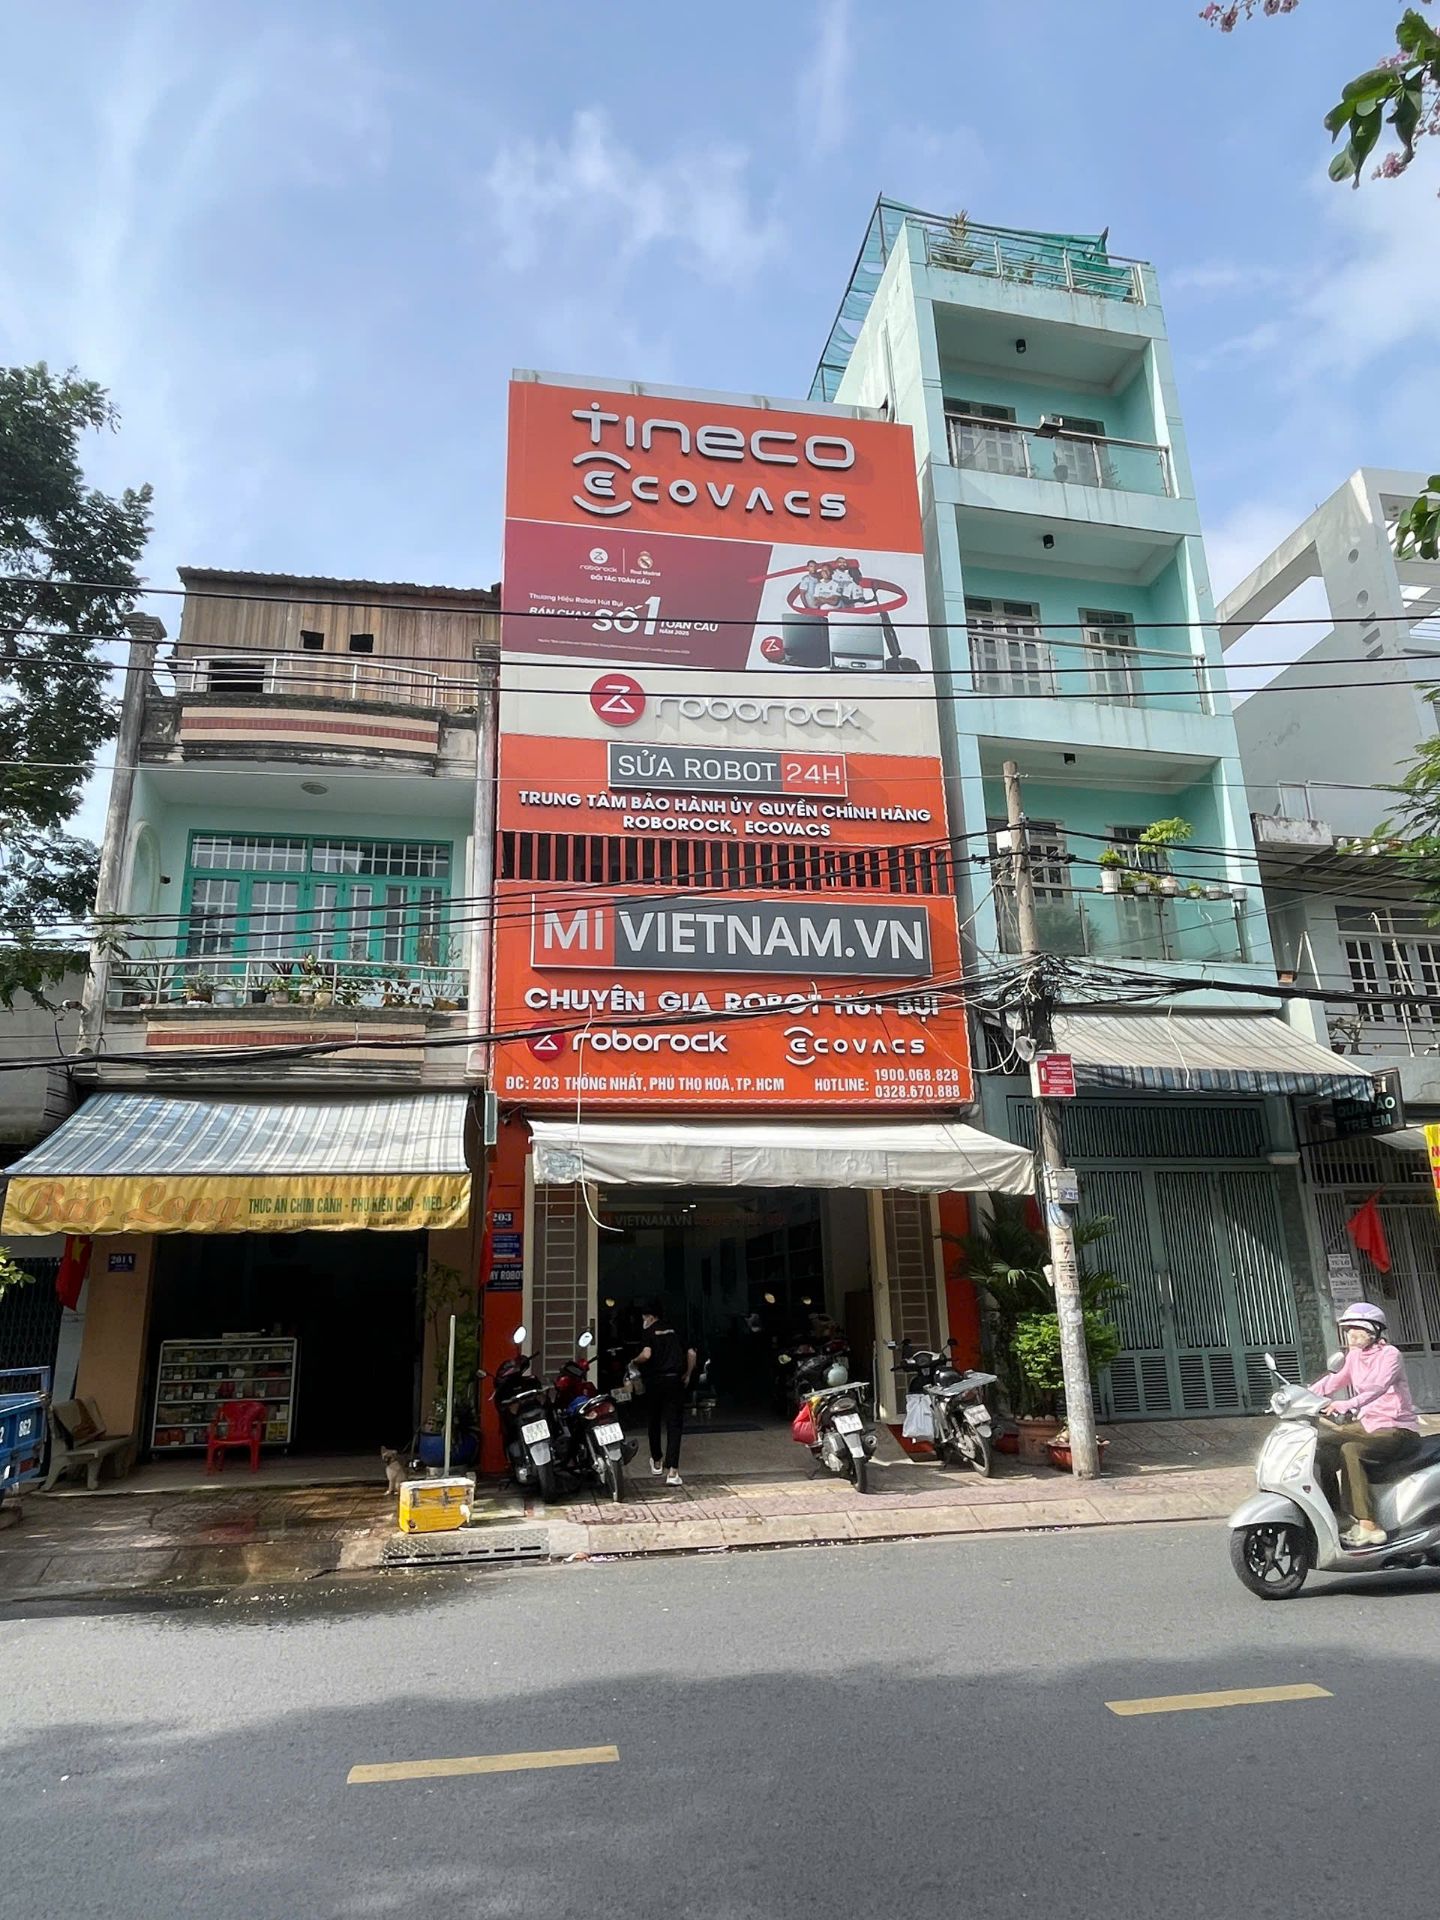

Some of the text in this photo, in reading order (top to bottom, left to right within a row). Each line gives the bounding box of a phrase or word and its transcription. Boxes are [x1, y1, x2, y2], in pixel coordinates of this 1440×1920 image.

[572, 402, 856, 468] tineco
[583, 471, 847, 518] ECOVACS
[579, 565, 617, 573] roborock
[575, 597, 597, 605] Robot
[644, 596, 661, 635] 1
[656, 698, 861, 729] roborock
[618, 749, 841, 785] SỬA ROBOT 24H
[519, 790, 931, 822] TRUNG TÂM BẢO HÀNH ỦY QUYỀN CHÍNH HÃNG
[623, 816, 831, 836] ROBOROCK, ECOVACS
[543, 908, 924, 961] MI VIETNAM.VN
[524, 983, 645, 1011] CHUYÊN
[658, 991, 711, 1012] GIA
[572, 1030, 925, 1055] roborock ECOVACS
[506, 1076, 530, 1090] ĐC:
[533, 1076, 560, 1090] 203
[564, 1072, 607, 1091] THỐNG
[609, 1071, 647, 1092] NHẤT,
[649, 1074, 675, 1091] PHÚ
[678, 1077, 702, 1094] THỌ
[815, 1079, 869, 1092] HOTLINE:
[874, 1068, 959, 1082] 1900.068.828
[875, 1084, 960, 1099] 0328.670.888
[1371, 1113, 1392, 1128] EM
[290, 1198, 315, 1213] CHIM
[615, 1214, 693, 1227] VIETNAM.VN
